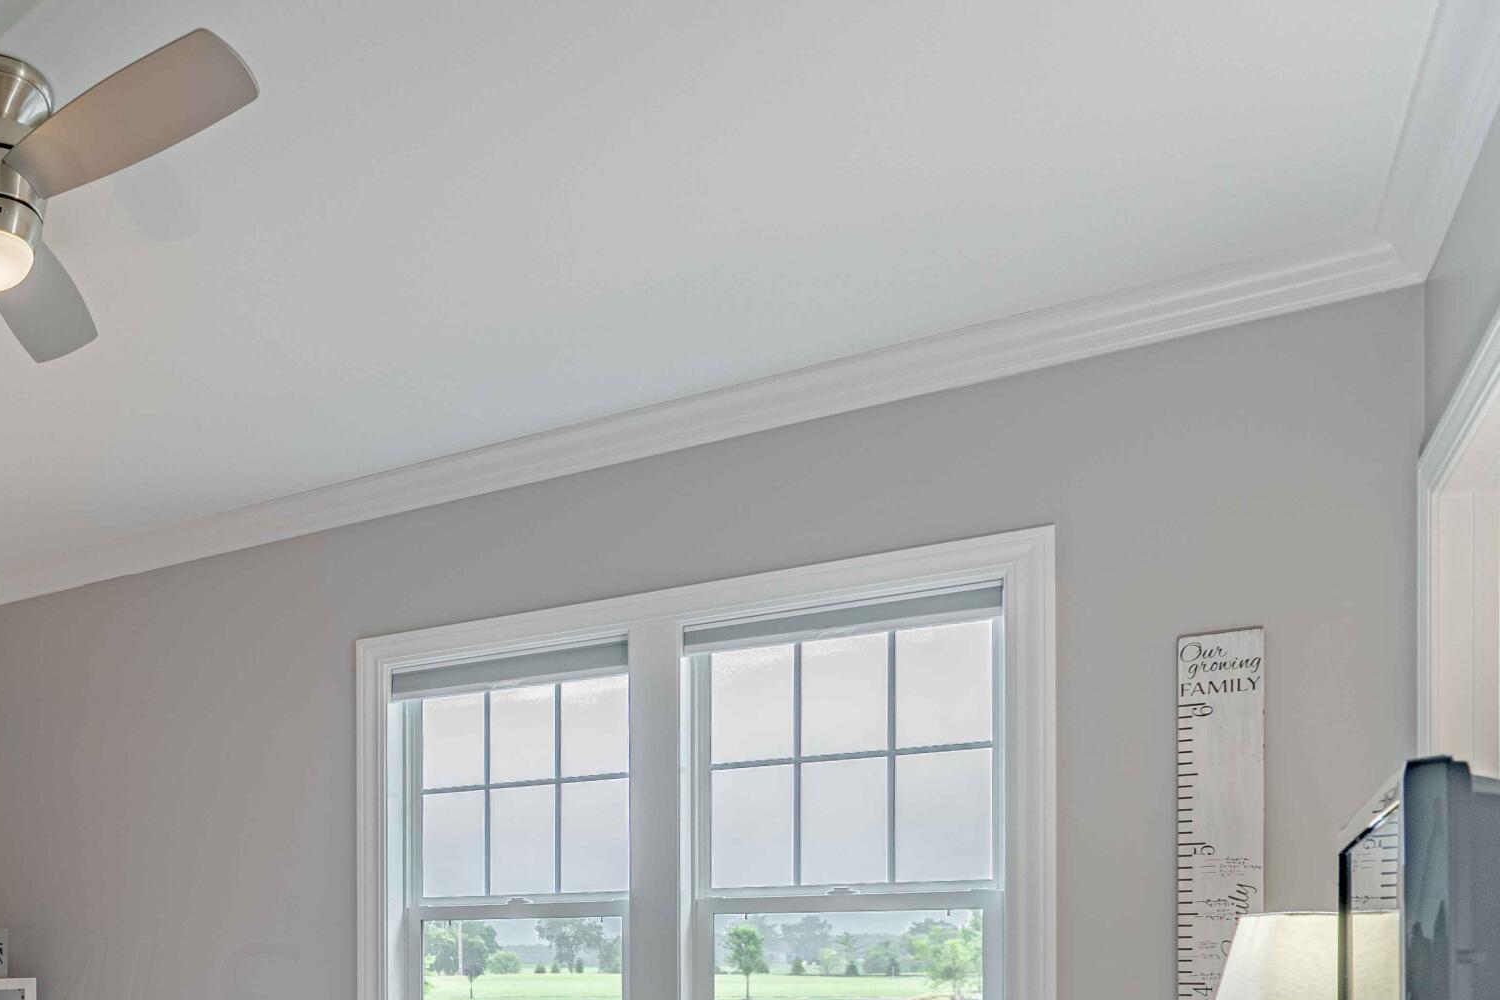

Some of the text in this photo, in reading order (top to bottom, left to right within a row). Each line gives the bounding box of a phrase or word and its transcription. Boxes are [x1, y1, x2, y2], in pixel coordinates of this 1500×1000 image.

[1180, 642, 1228, 662] Our
[1188, 657, 1261, 679] growing
[1180, 676, 1260, 697] FAMILY
[1192, 705, 1213, 717] 6
[1192, 845, 1215, 857] 5
[1192, 986, 1212, 997] 4
